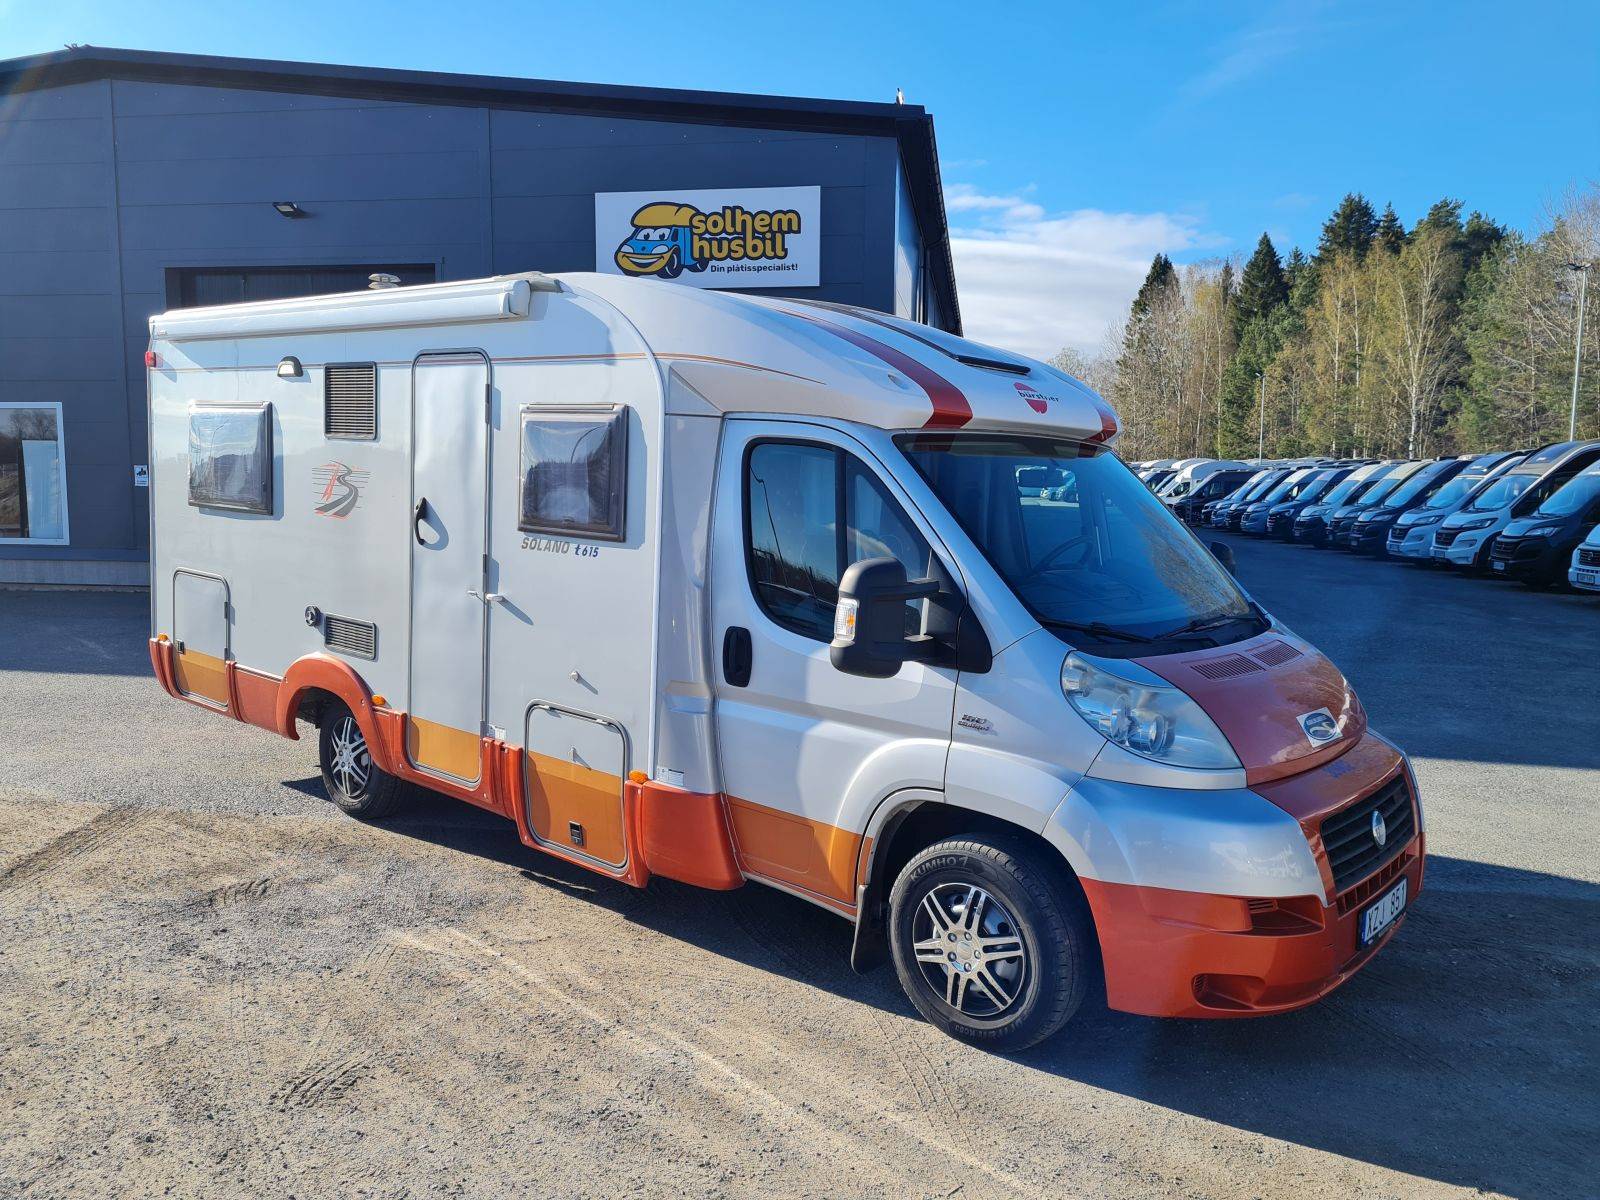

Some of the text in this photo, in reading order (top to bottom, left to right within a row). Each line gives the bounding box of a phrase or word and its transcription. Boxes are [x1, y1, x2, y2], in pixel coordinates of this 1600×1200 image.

[689, 205, 801, 236] solhem
[691, 232, 788, 260] husbil
[710, 263, 799, 274] Din plåtisspecialist!
[521, 537, 600, 558] SOLANO t615
[910, 856, 957, 881] KUMHO
